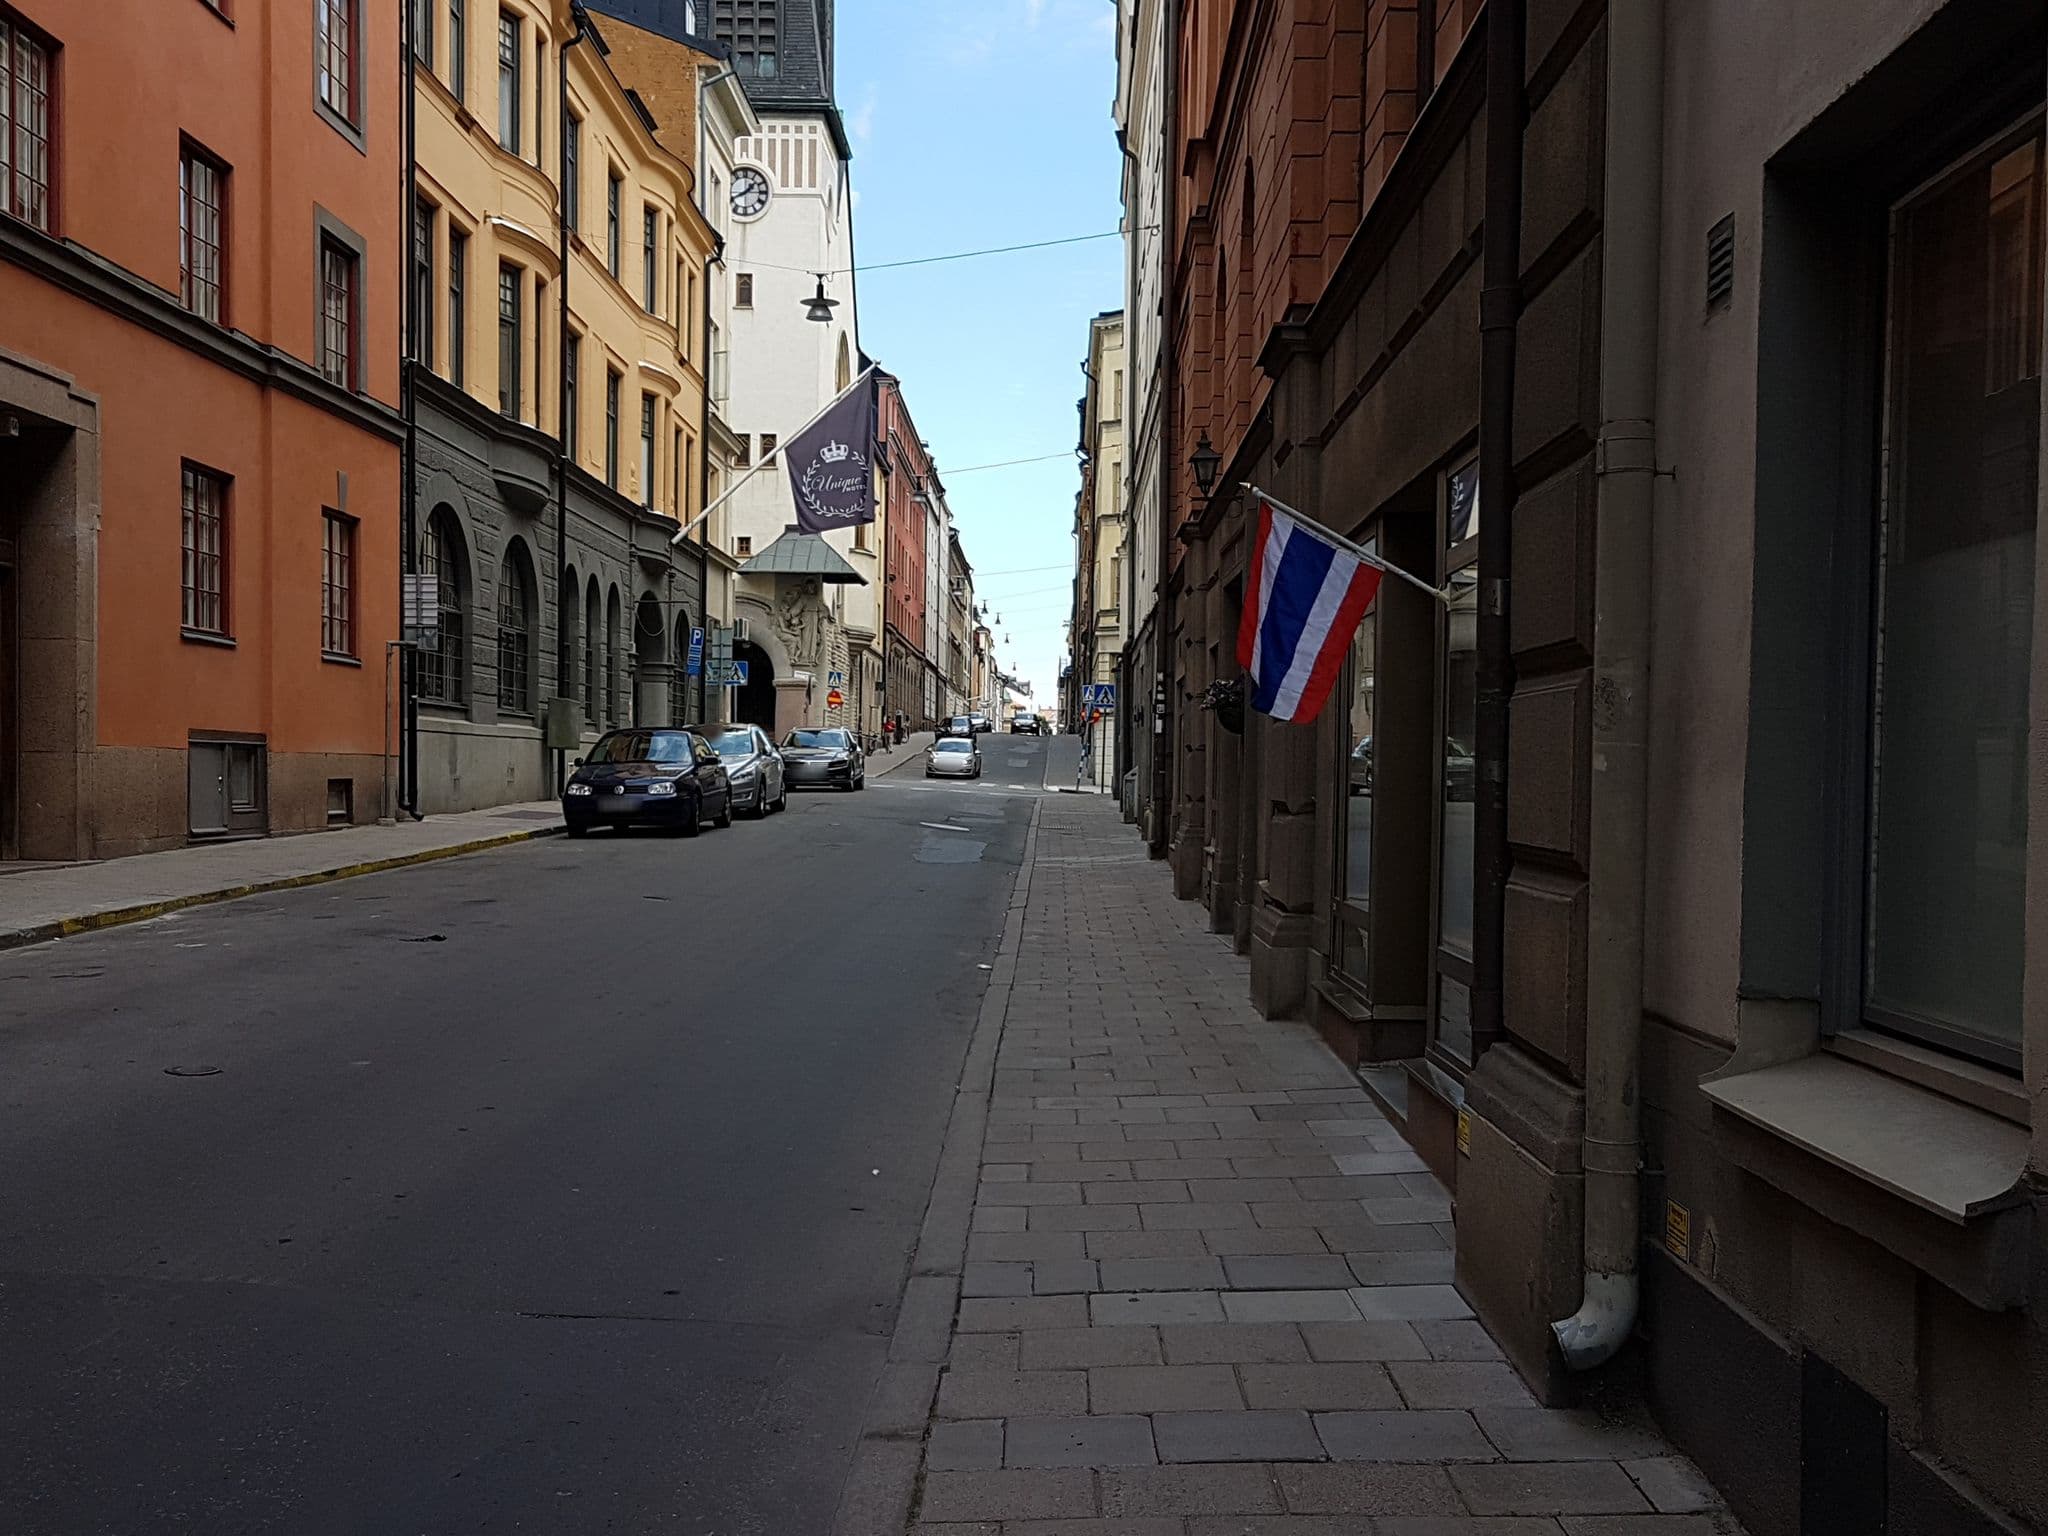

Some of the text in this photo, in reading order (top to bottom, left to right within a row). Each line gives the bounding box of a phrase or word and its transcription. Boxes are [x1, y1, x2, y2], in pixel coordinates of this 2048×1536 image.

[811, 474, 862, 493] Unique
[846, 484, 867, 492] HOTEL
[692, 629, 702, 644] P
